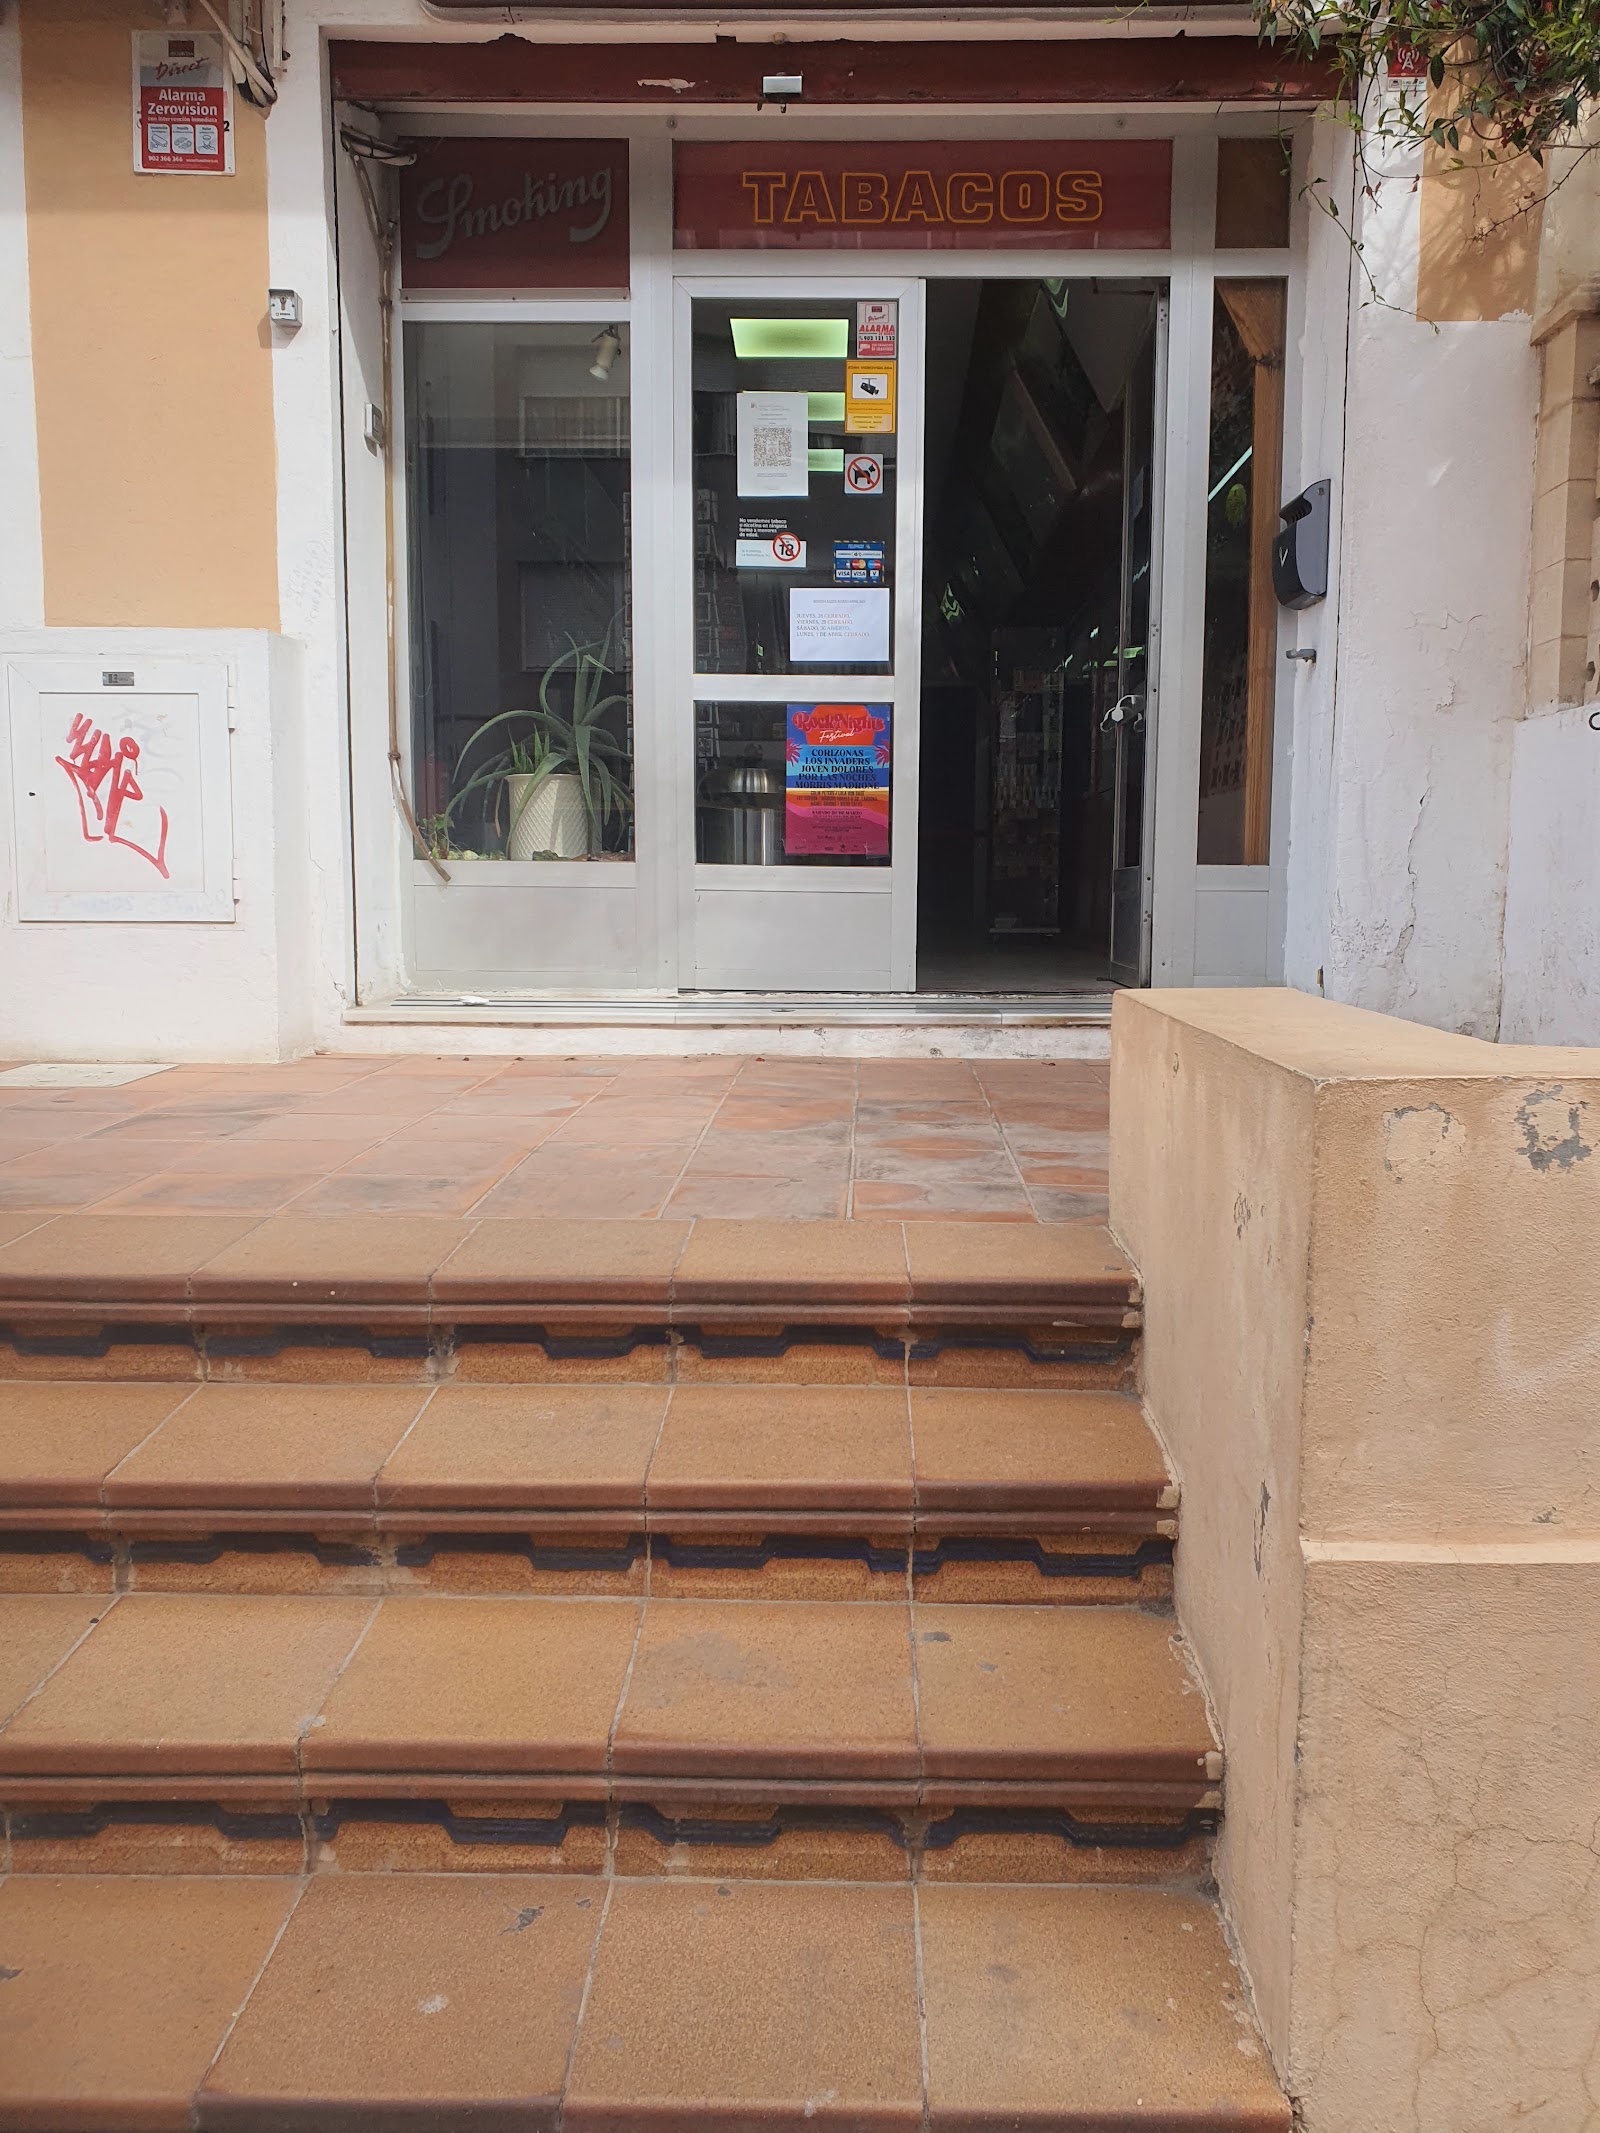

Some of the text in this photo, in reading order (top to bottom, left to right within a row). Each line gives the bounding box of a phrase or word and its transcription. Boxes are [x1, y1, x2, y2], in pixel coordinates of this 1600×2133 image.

[159, 89, 206, 102] Alarma
[147, 102, 218, 116] Zerovision
[742, 170, 1103, 224] TABACOS
[416, 167, 612, 259] Smoking
[859, 324, 895, 332] ALARMA
[779, 543, 794, 557] 18
[819, 728, 855, 743] Festival
[811, 748, 864, 757] CORIZONAS
[805, 757, 870, 766] LOS INVADERS
[801, 765, 874, 774] JOVEN DOLORES
[798, 773, 877, 782] POR LAS NOCHES
[795, 781, 879, 789] MORRIS MADRONE
